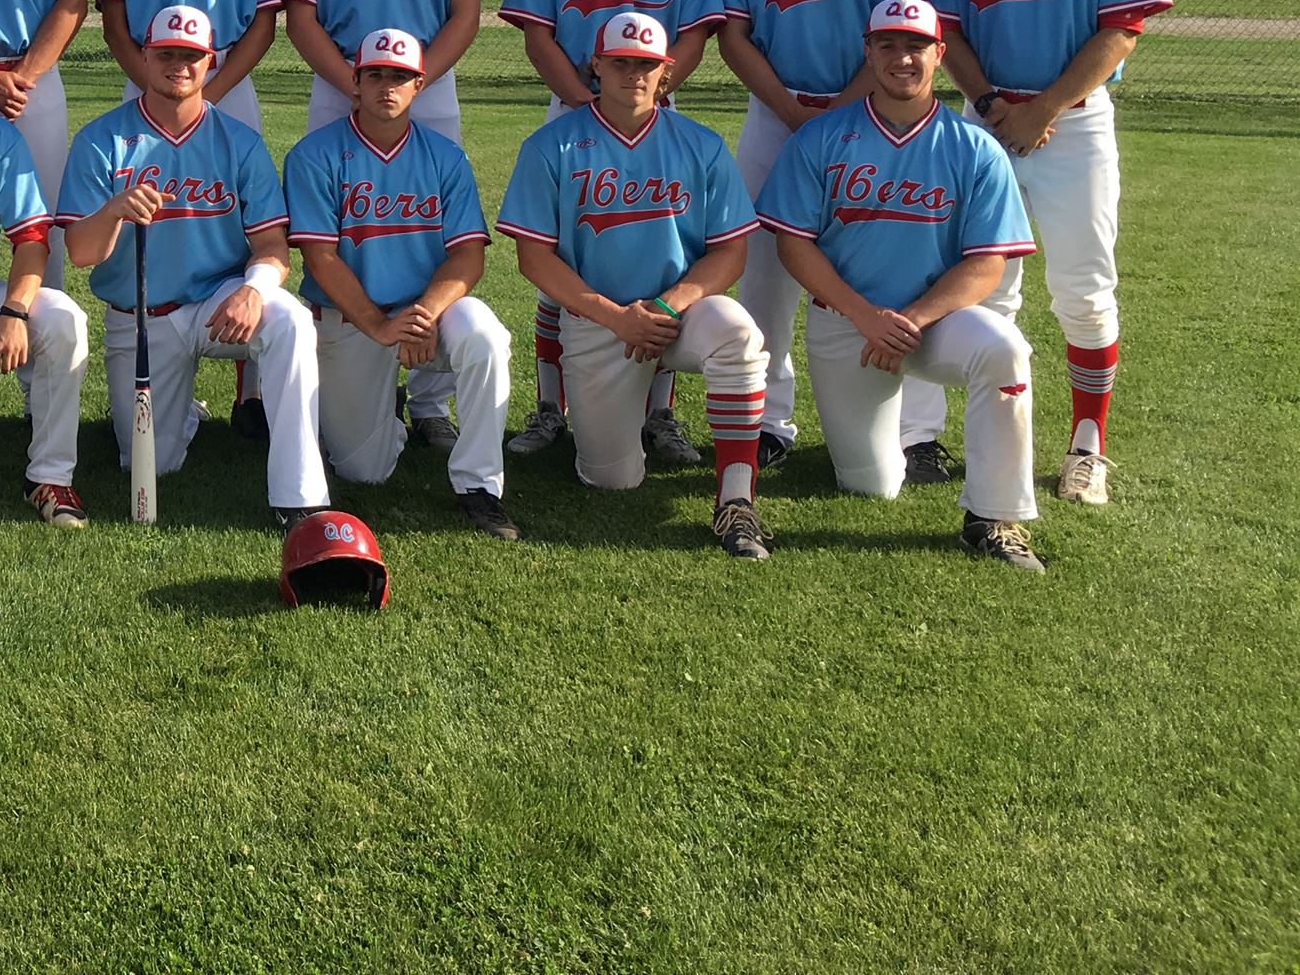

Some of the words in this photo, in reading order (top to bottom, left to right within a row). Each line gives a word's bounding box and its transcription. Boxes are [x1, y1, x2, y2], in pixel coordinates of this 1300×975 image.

[571, 168, 690, 209] 76ers
[827, 162, 955, 209] 76ers
[324, 522, 355, 543] QC
